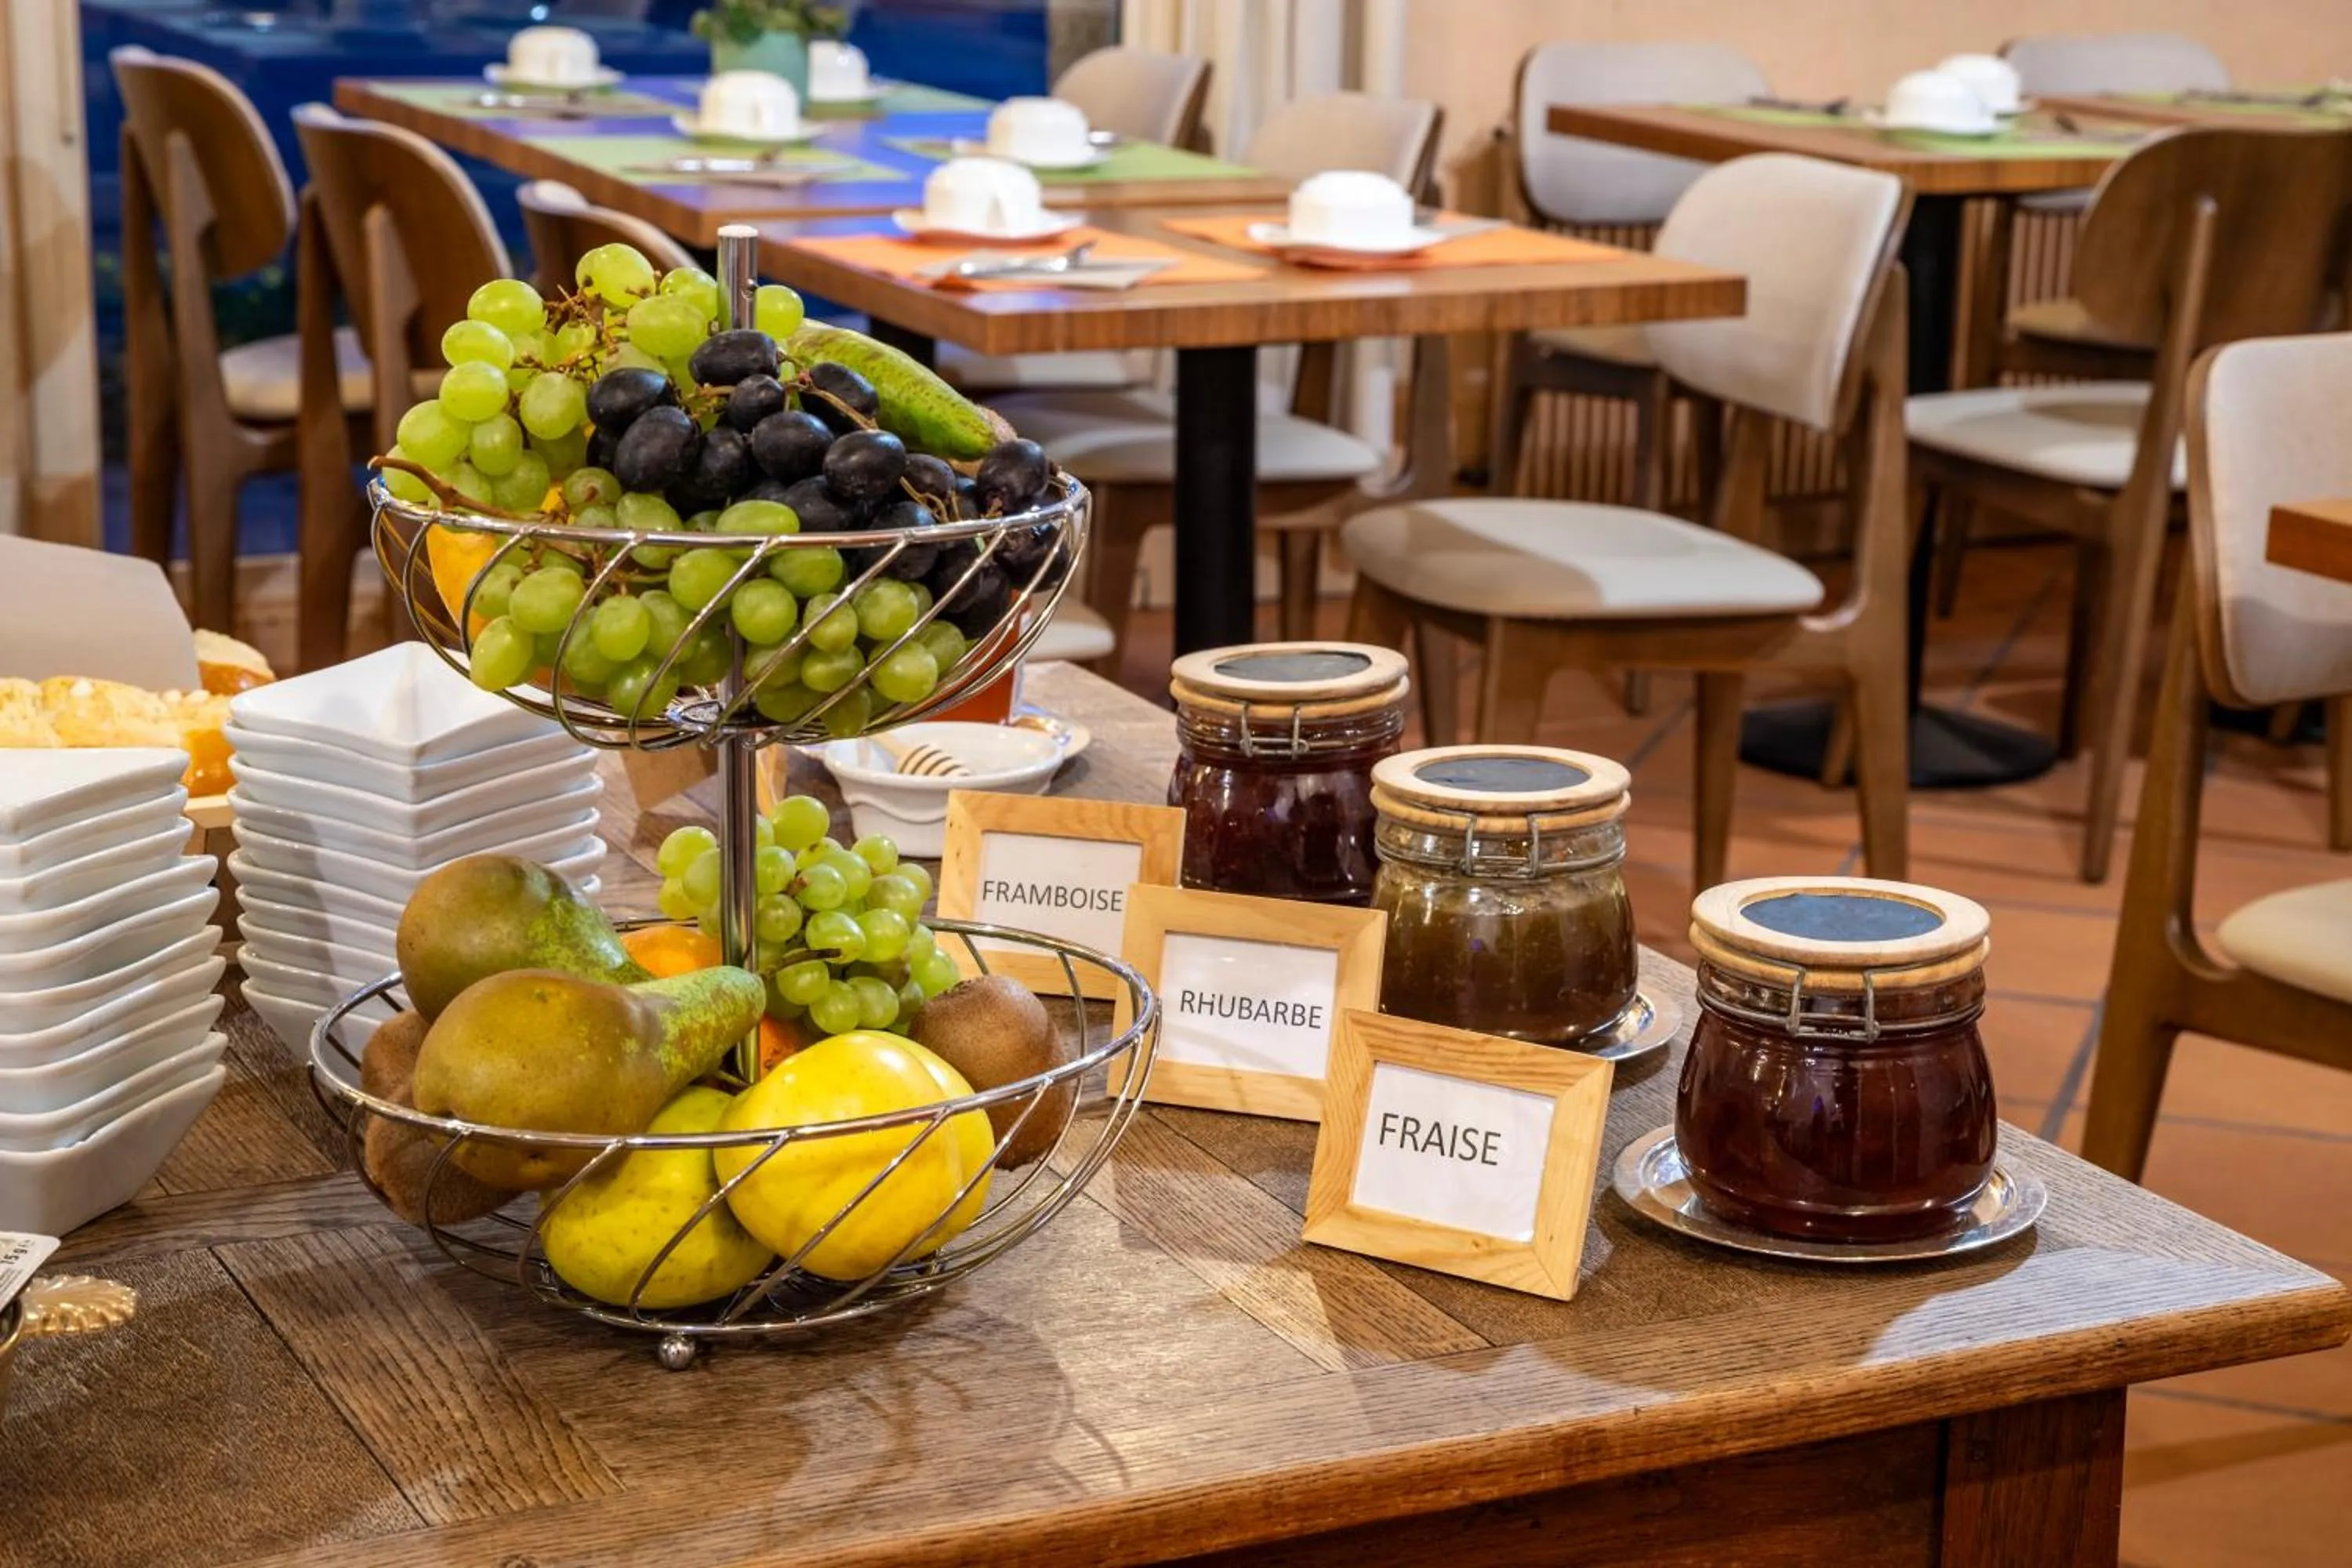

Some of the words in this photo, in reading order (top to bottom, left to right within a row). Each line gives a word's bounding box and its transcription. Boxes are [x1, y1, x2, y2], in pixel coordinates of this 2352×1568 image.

[982, 880, 1123, 912] FRAMBOISE
[1180, 990, 1323, 1029] RHUBARBE
[1379, 1112, 1501, 1166] FRAISE
